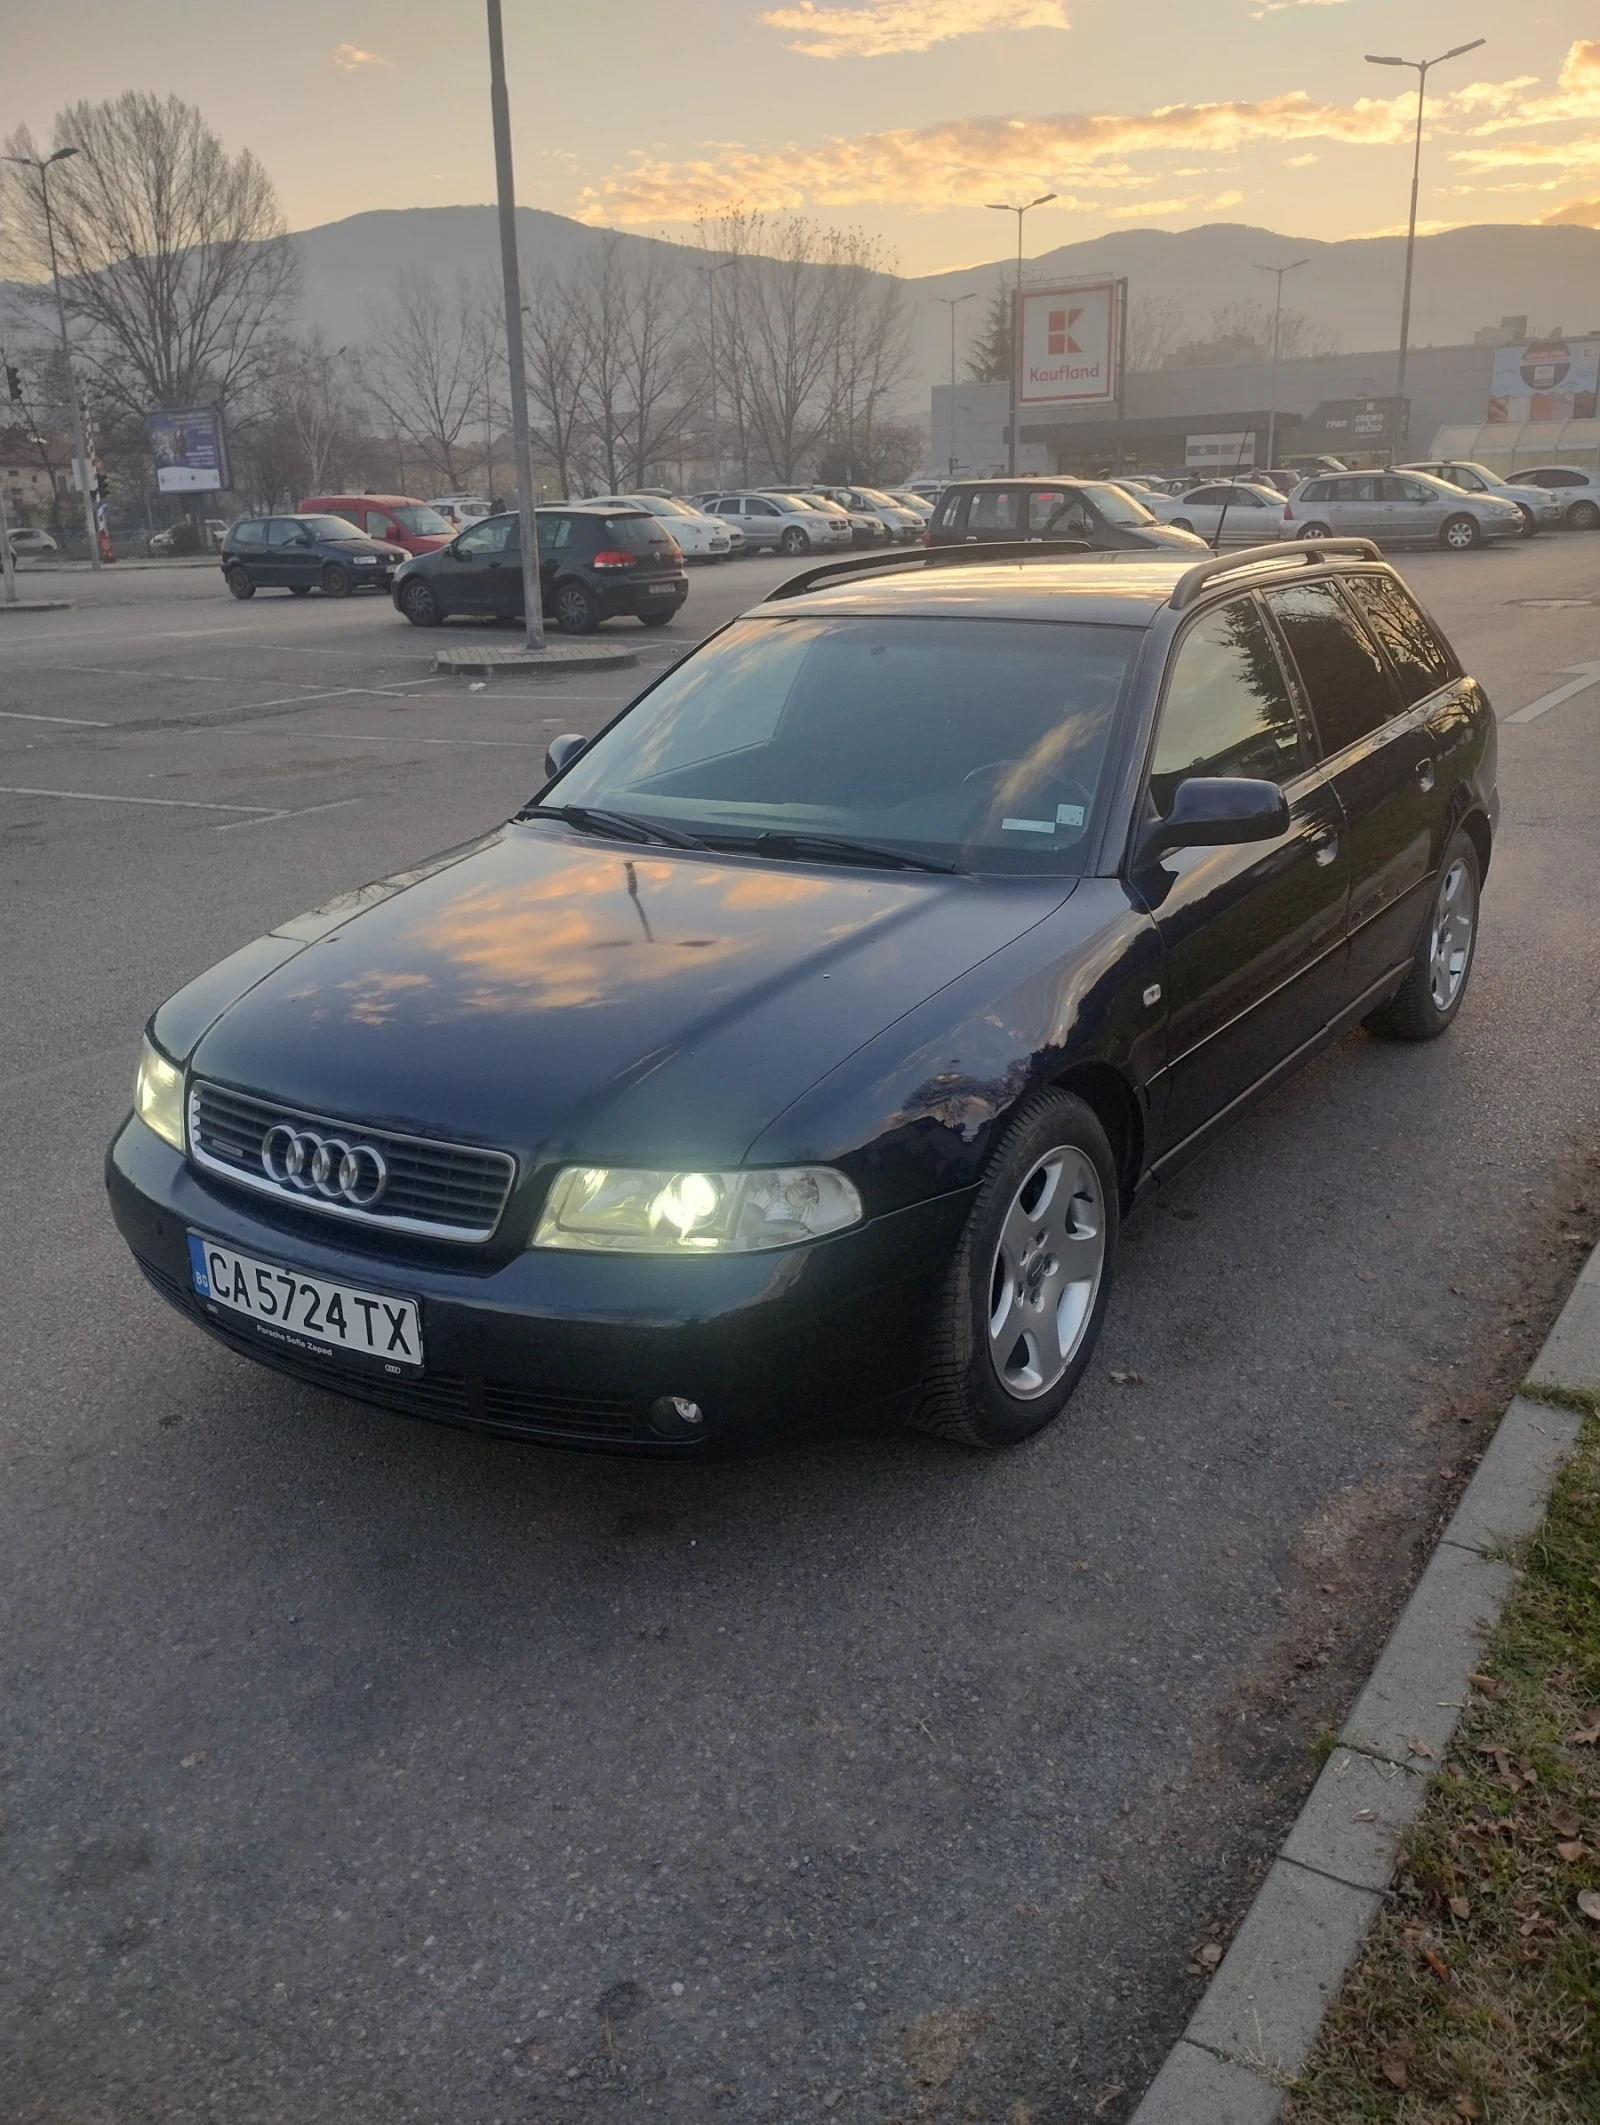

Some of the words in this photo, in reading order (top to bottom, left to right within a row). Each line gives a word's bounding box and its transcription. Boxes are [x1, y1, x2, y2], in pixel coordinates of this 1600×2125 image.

[1029, 362, 1100, 383] Kaufland
[195, 1271, 208, 1288] BG
[256, 1324, 286, 1341] Porsche
[286, 1335, 306, 1348] Sofia
[307, 1342, 333, 1356] Zapad
